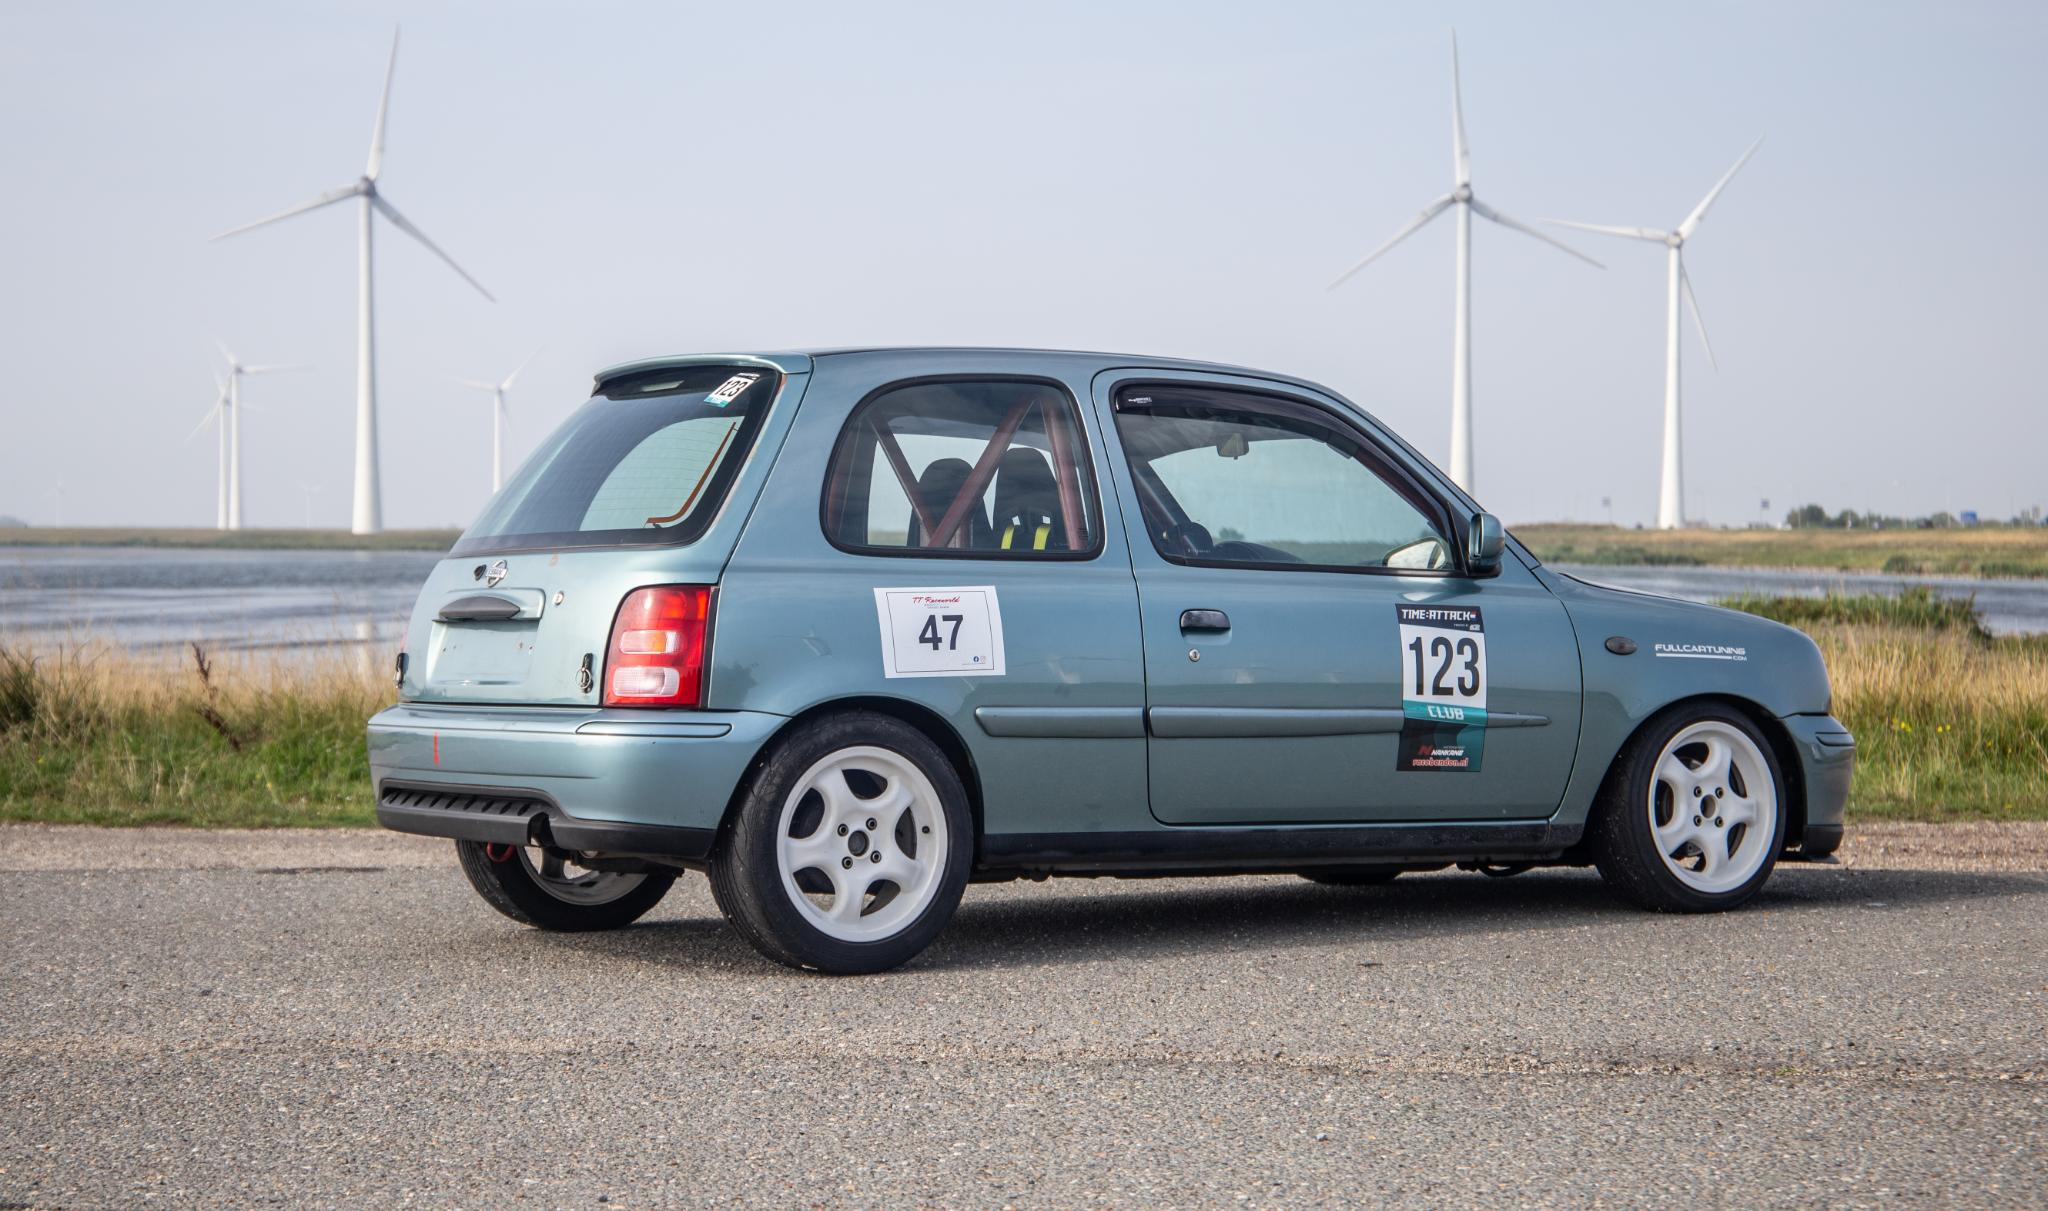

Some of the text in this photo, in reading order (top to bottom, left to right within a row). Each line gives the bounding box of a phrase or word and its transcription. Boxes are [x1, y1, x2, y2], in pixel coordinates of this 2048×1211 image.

[714, 380, 749, 397] 123
[919, 614, 963, 651] 47
[1655, 643, 1746, 655] FULLCARTUNING
[1409, 636, 1480, 697] 123
[1427, 705, 1465, 720] CLUB
